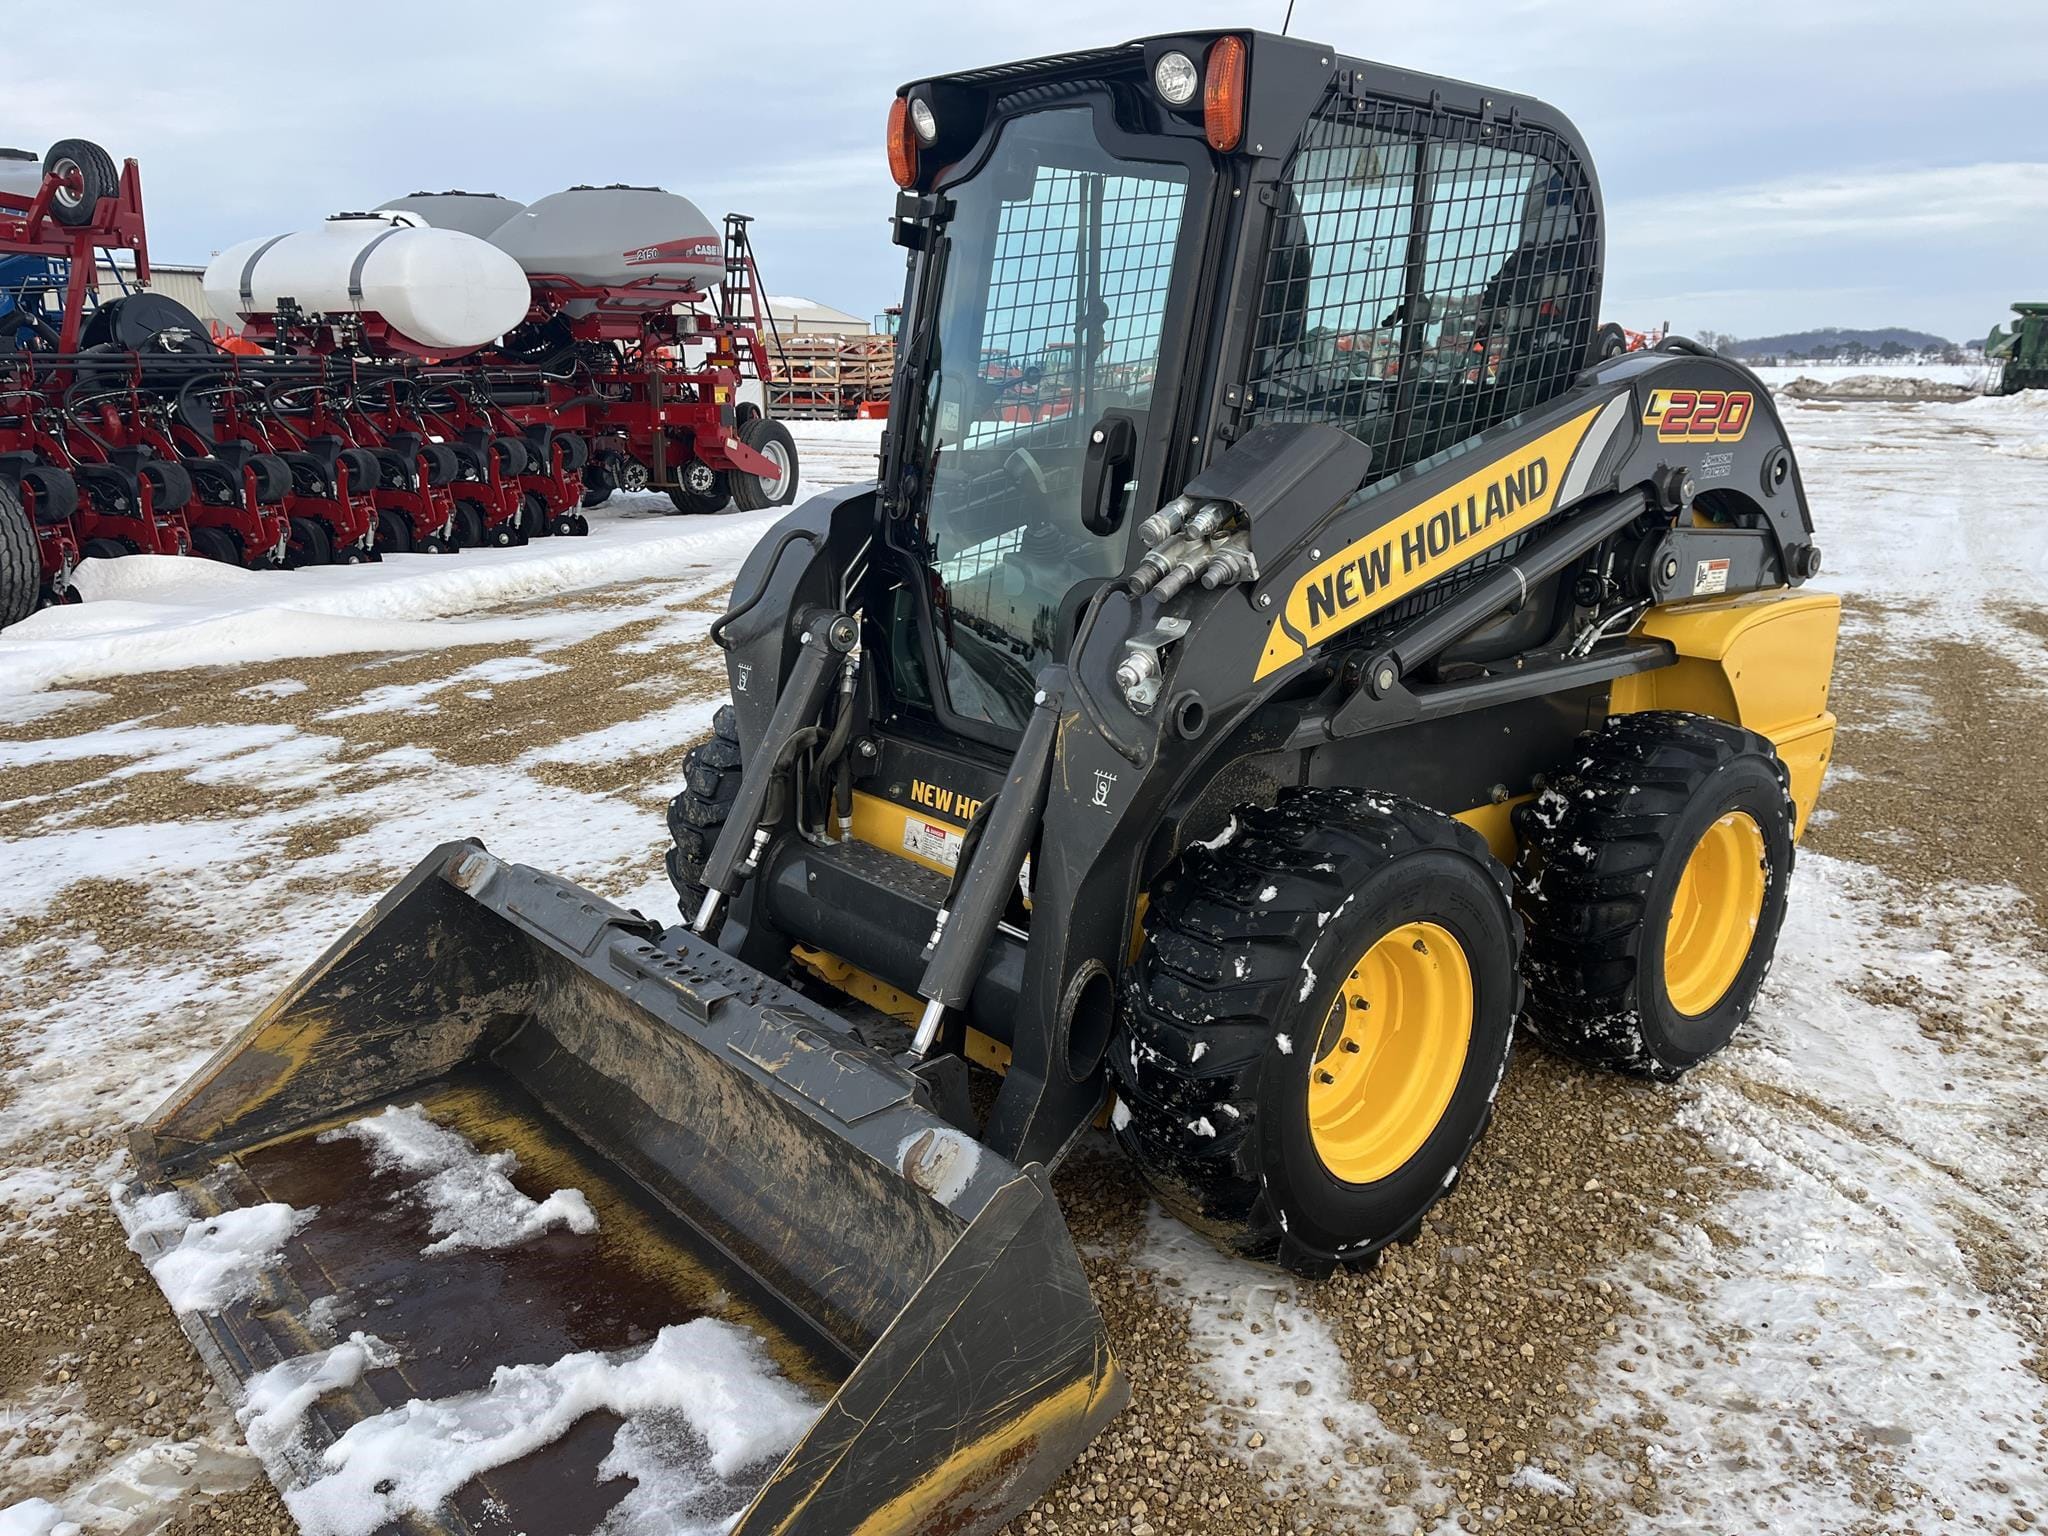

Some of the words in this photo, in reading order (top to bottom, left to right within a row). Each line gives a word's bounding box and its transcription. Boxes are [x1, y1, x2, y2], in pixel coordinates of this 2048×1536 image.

[636, 247, 659, 261] 2150
[1643, 389, 1753, 441] L220
[1305, 540, 1393, 629] NEW
[1400, 455, 1549, 576] HOLLAND
[911, 779, 954, 813] NEW
